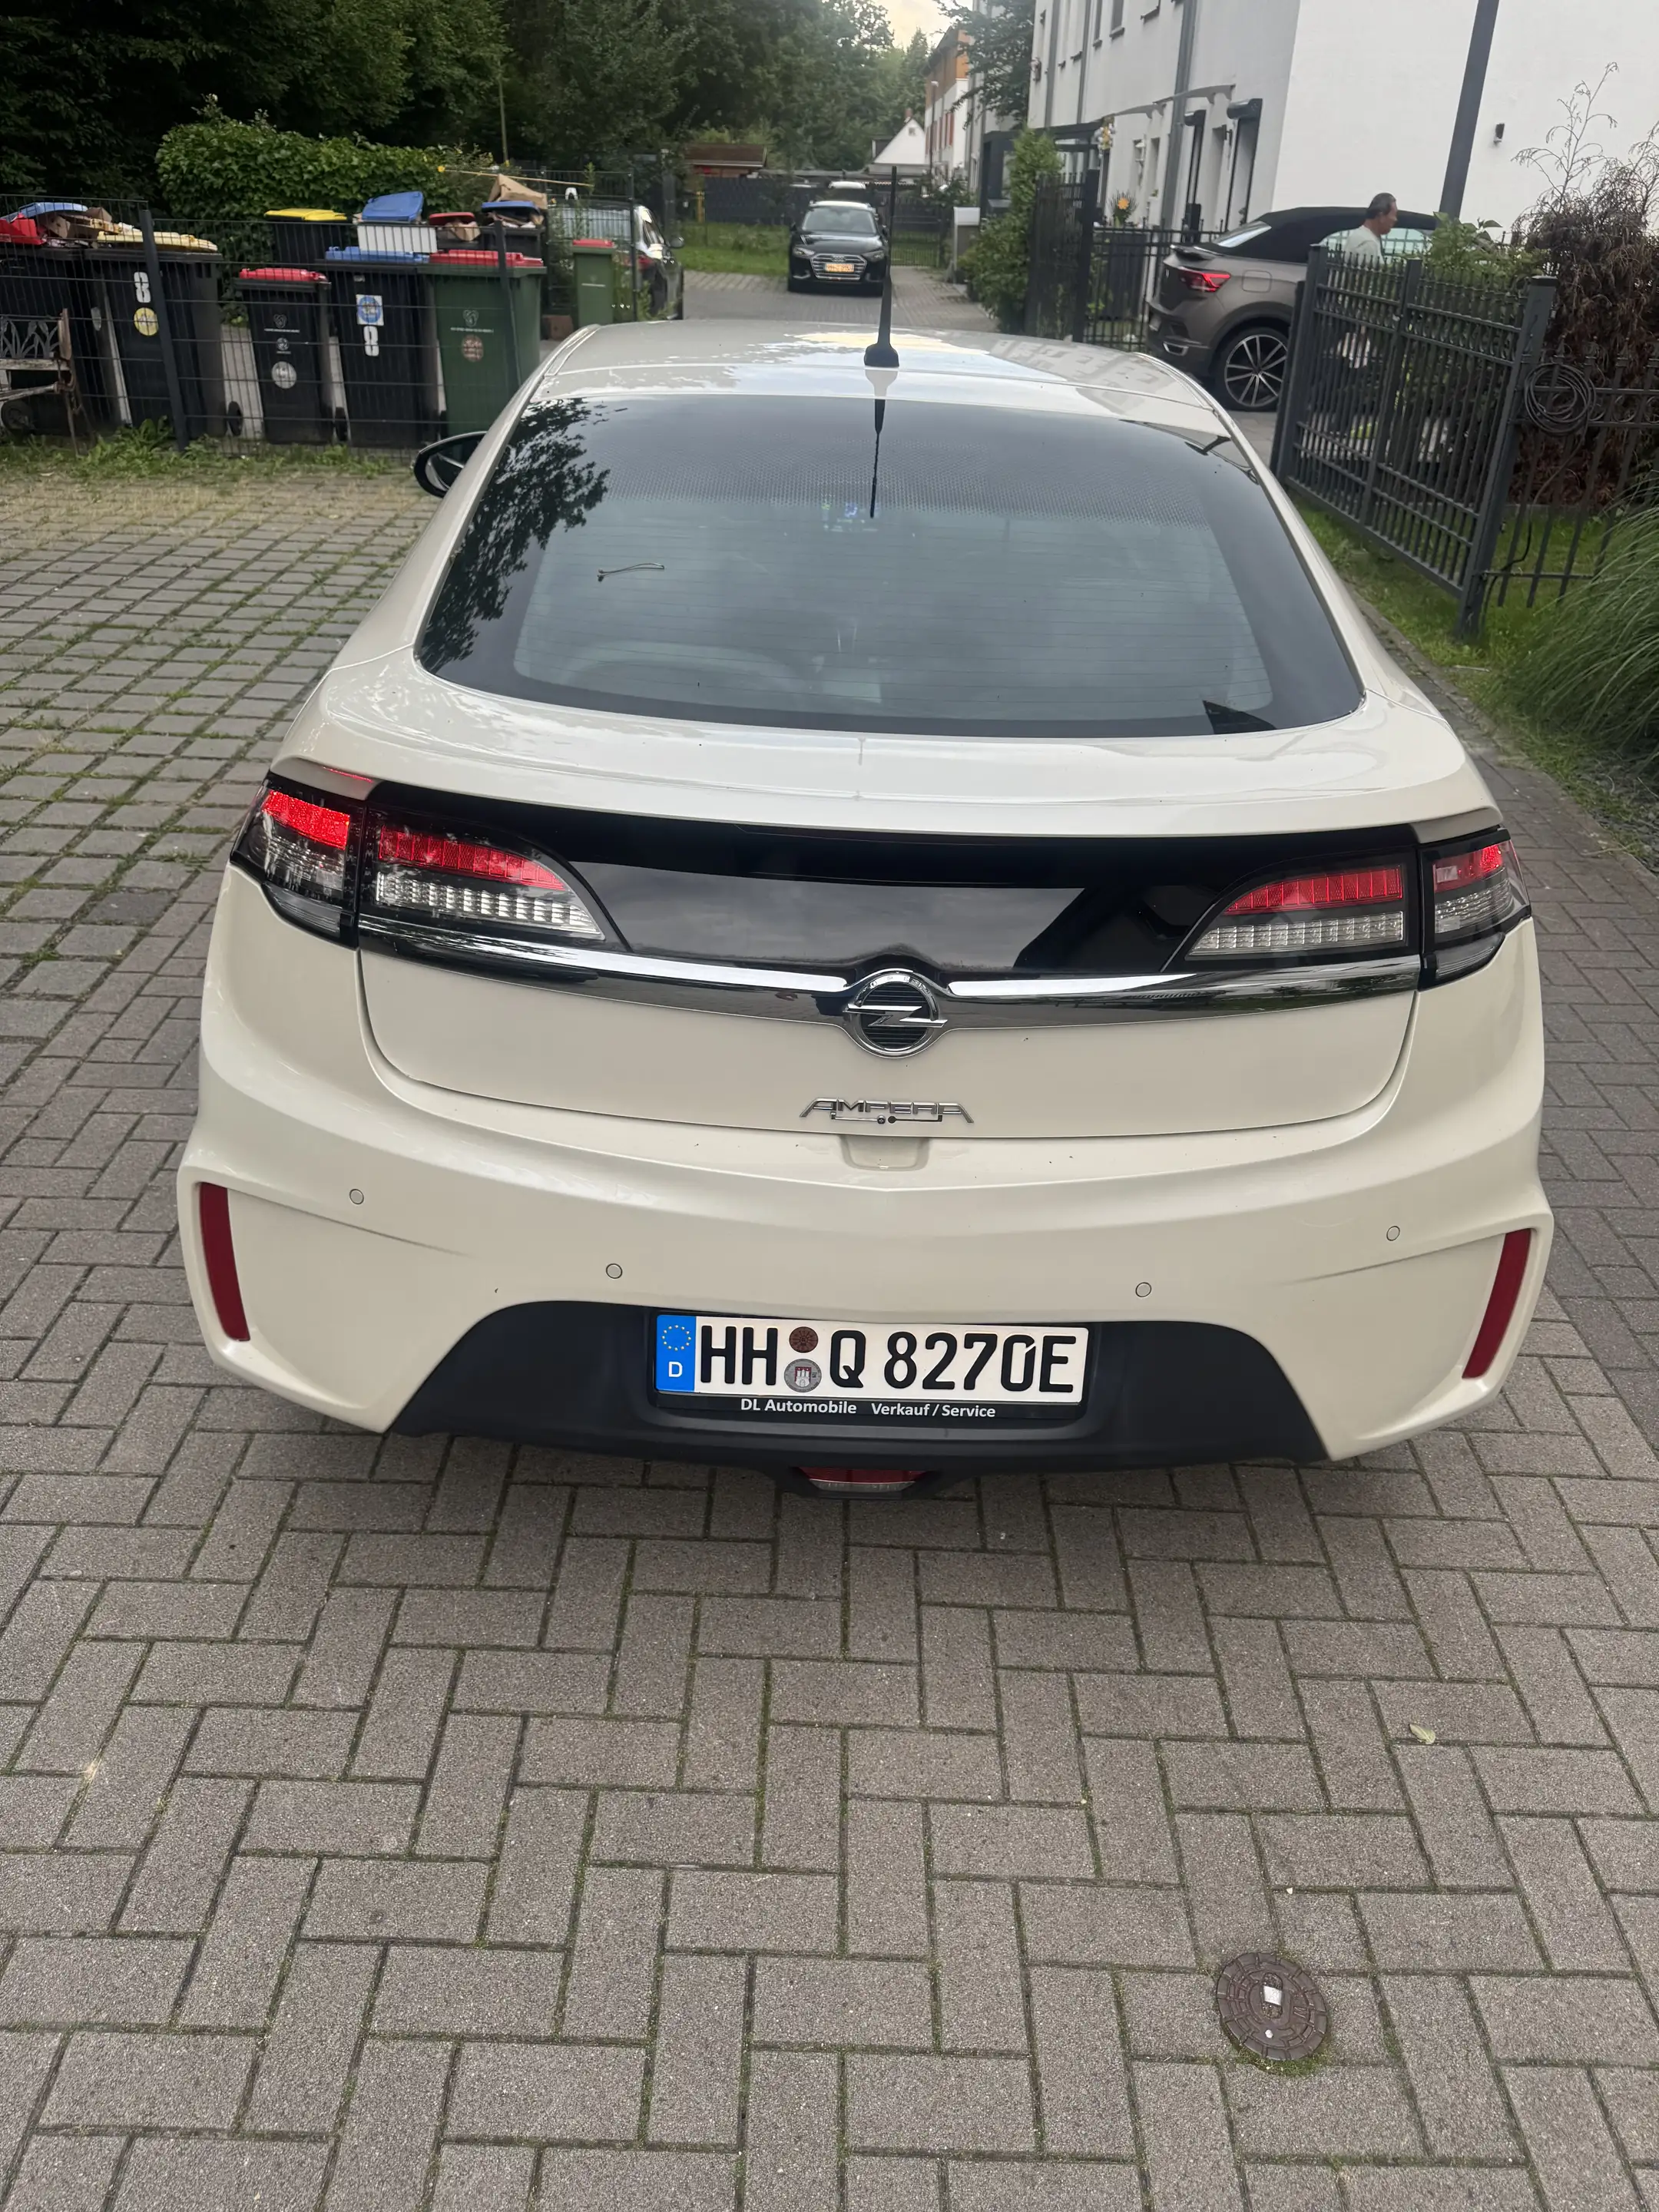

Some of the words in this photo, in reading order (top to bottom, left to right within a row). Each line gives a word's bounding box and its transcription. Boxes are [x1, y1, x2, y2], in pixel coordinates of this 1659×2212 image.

[799, 1097, 975, 1124] AMPERA
[667, 1361, 683, 1378] D
[700, 1325, 779, 1386] HH
[830, 1330, 866, 1389] Q
[883, 1331, 1077, 1393] 8270E
[740, 1398, 760, 1412] DL
[764, 1399, 857, 1415] Automobile
[871, 1402, 932, 1416] Verkauf
[941, 1404, 996, 1418] Service
